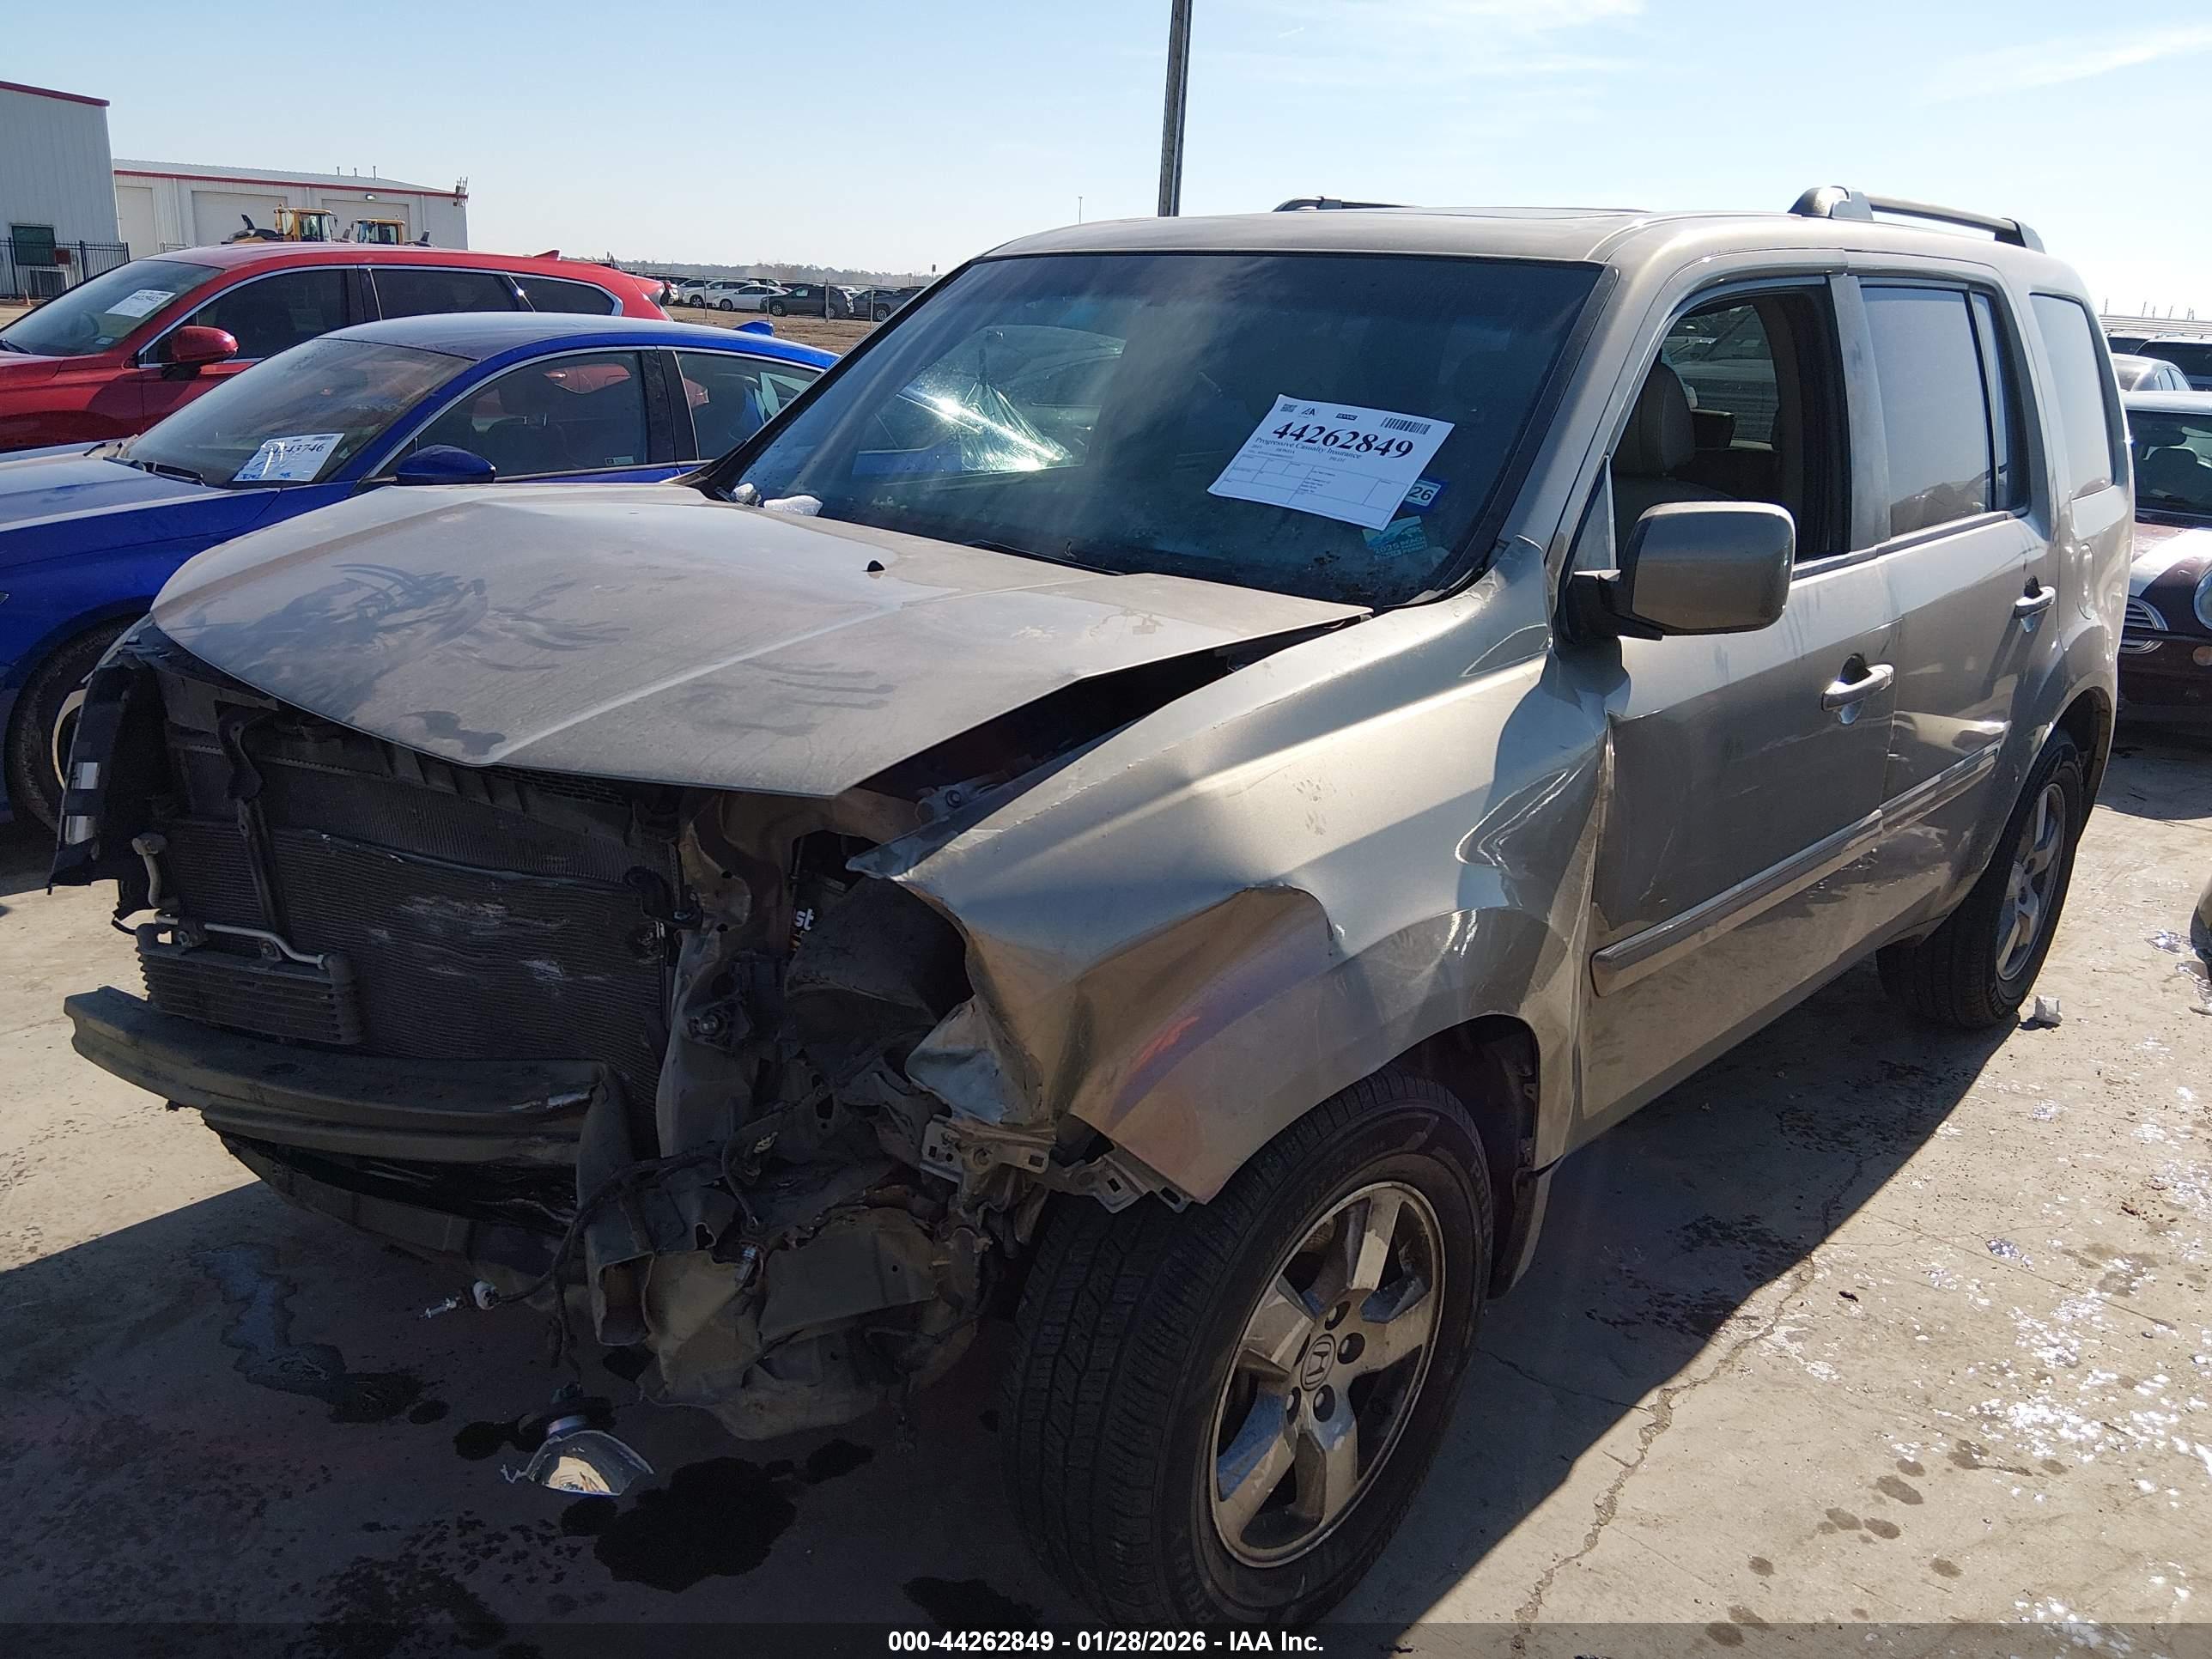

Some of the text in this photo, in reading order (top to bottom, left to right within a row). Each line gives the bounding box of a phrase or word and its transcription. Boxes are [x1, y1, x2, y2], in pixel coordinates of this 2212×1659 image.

[1272, 421, 1413, 458] 44262849
[1295, 442, 1324, 454] Casualty
[1327, 447, 1362, 459] Insurance
[1408, 486, 1434, 501] 26
